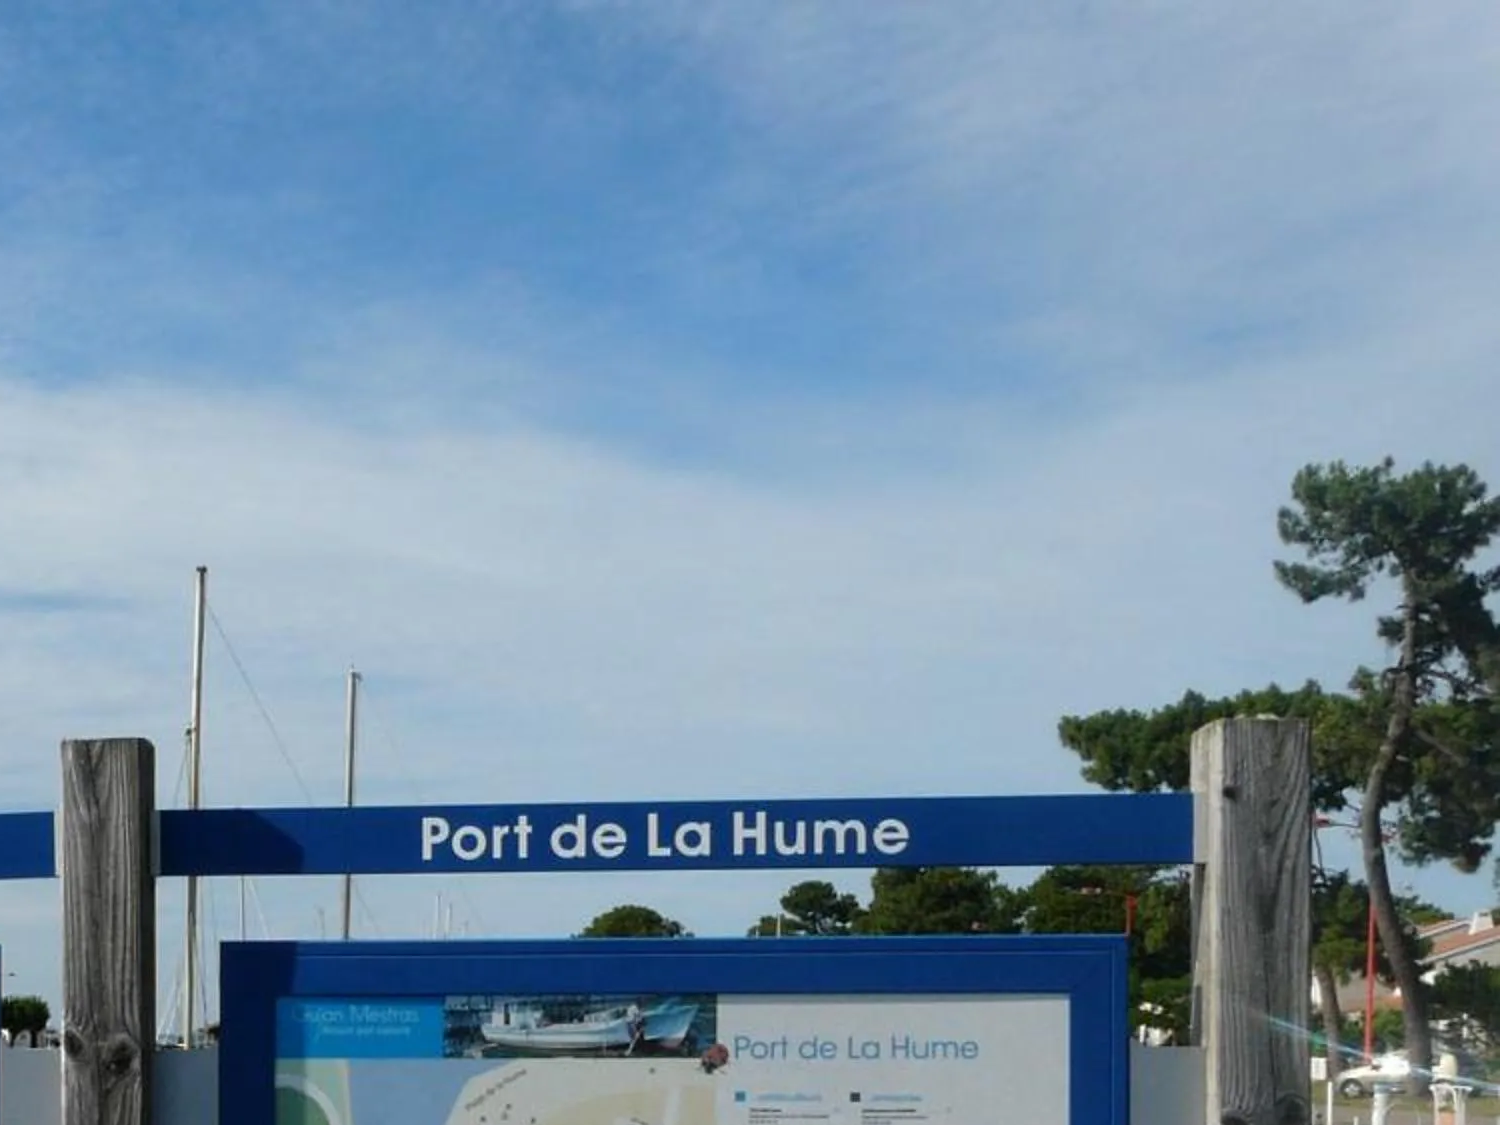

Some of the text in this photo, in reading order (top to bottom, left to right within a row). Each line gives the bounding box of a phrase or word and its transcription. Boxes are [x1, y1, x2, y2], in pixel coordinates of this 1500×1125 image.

[422, 811, 910, 861] Port de La Hume
[734, 1035, 979, 1060] Port de La Hume
